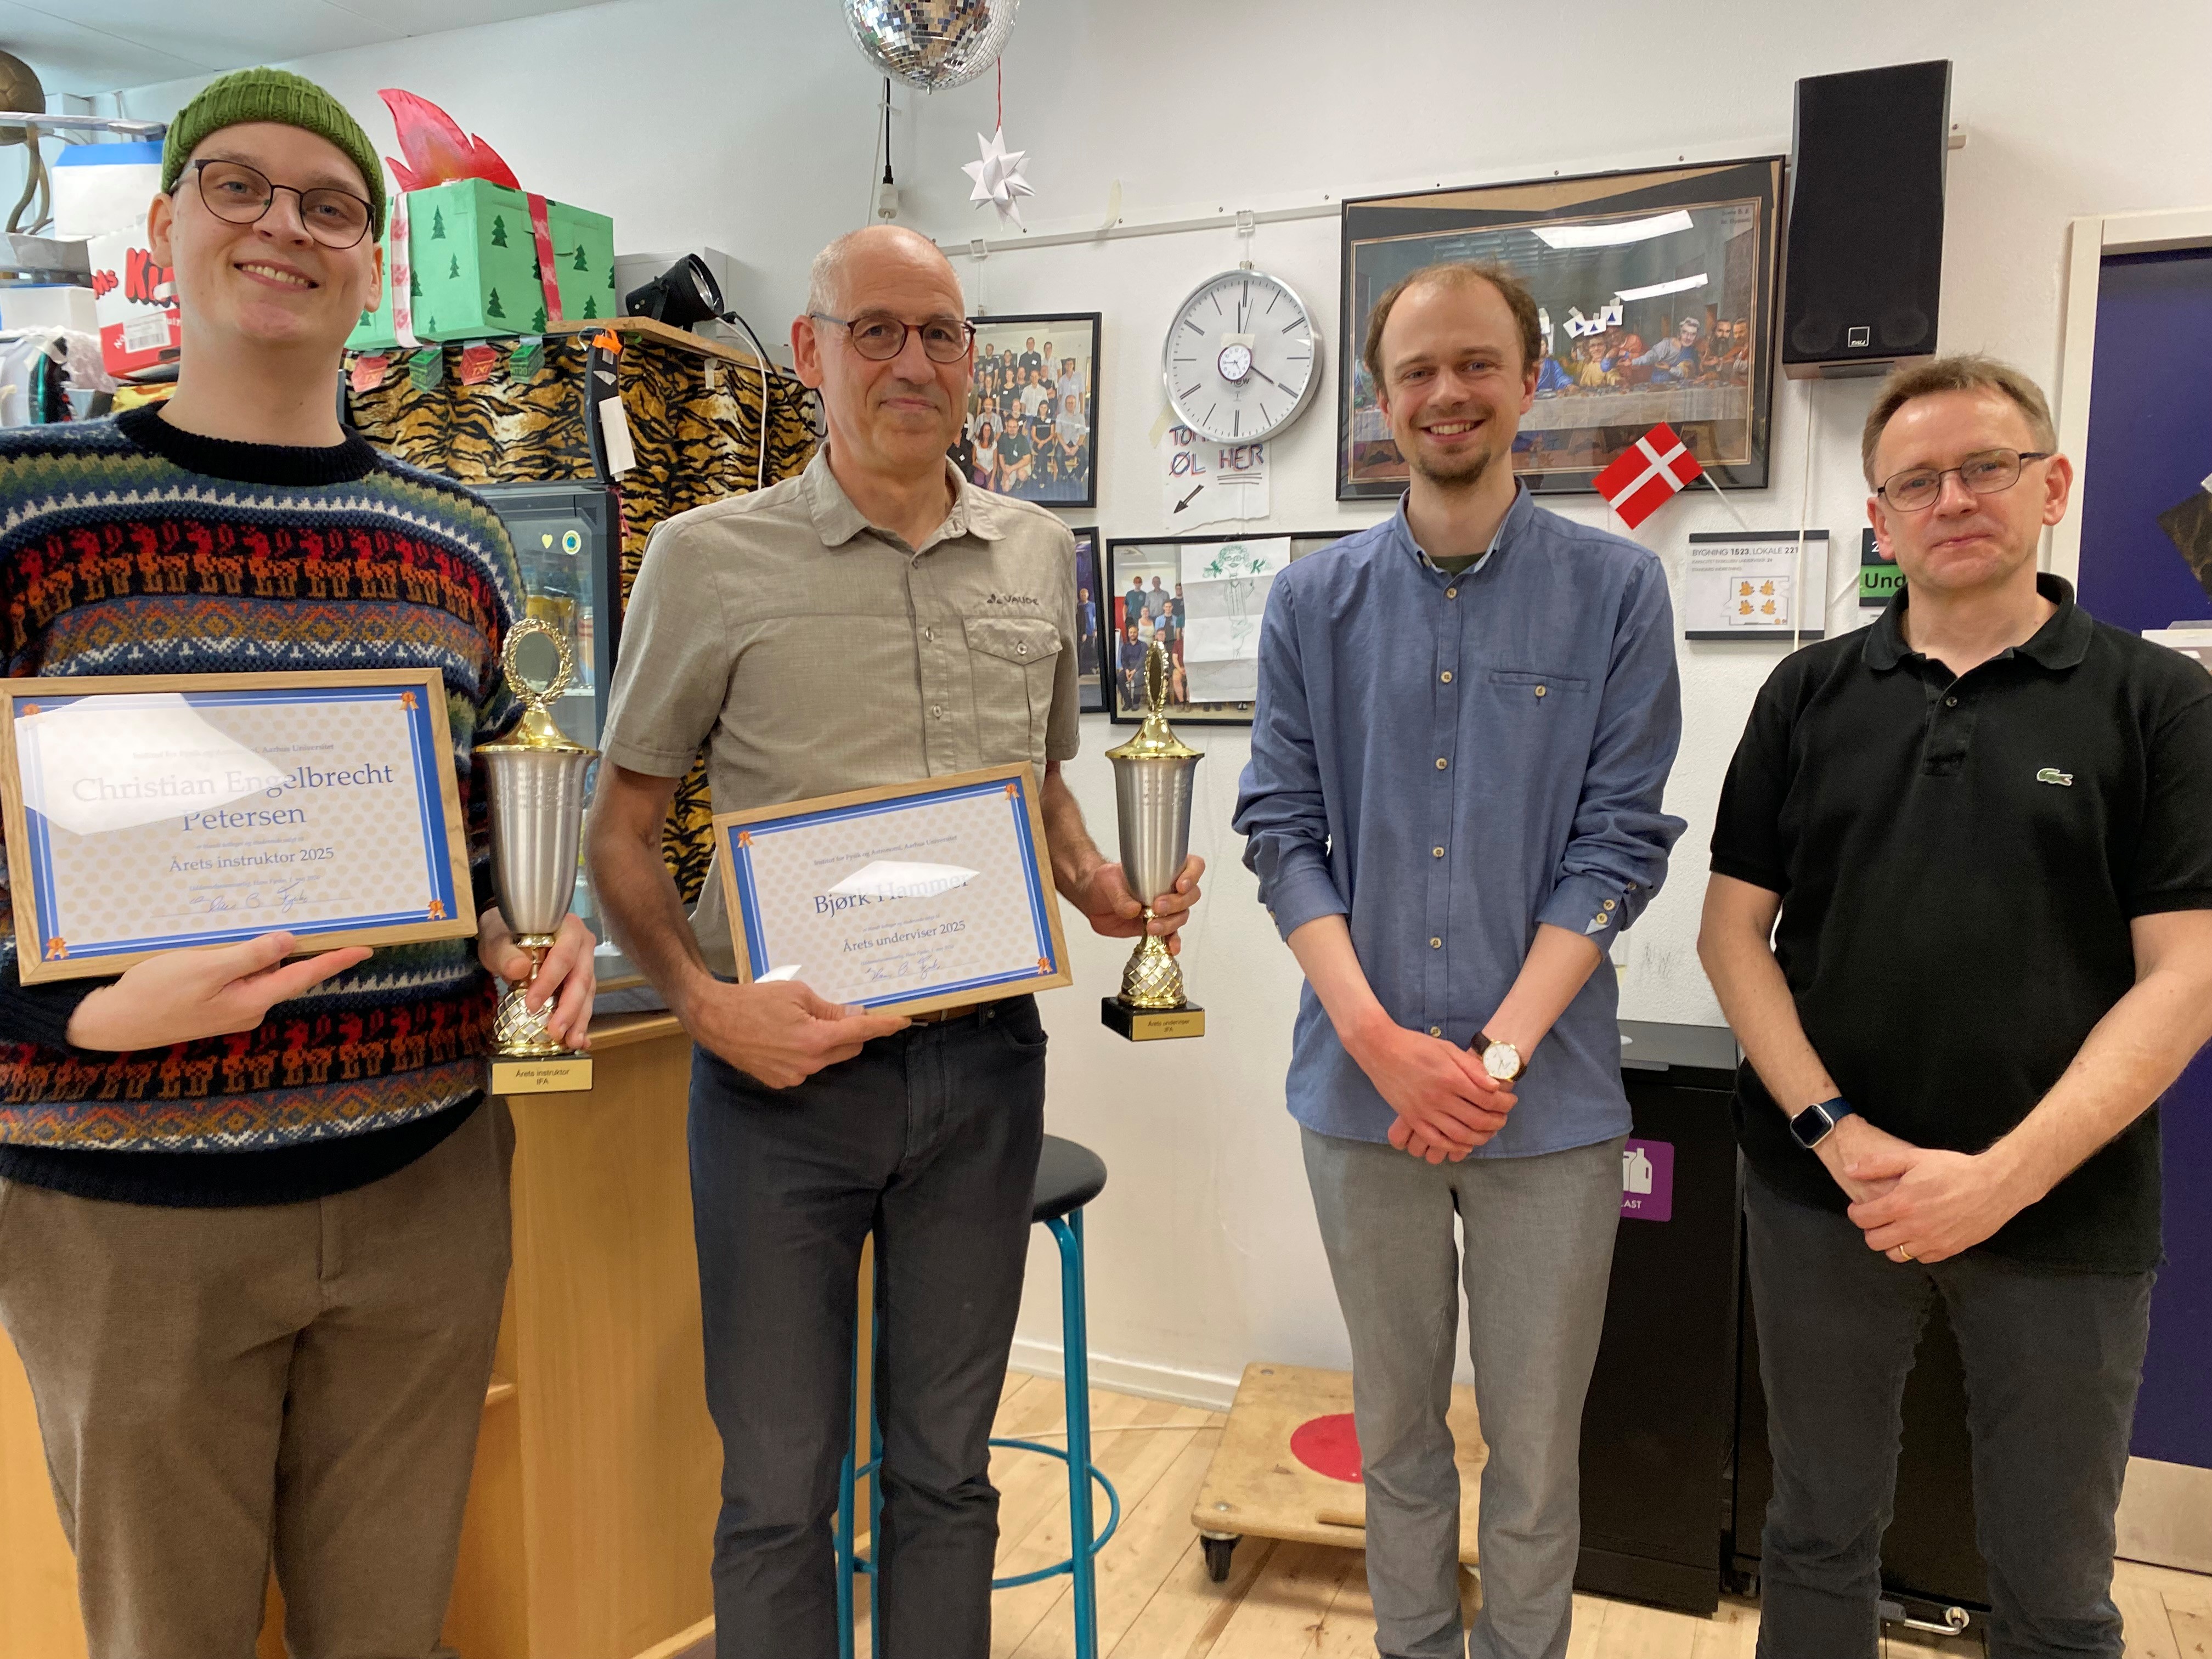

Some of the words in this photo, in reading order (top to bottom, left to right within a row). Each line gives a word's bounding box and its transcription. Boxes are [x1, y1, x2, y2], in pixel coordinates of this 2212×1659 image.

[125, 247, 180, 307] Ki
[1169, 425, 1210, 447] TO
[1169, 450, 1206, 477] ØL
[1219, 444, 1264, 471] HER
[1871, 541, 1880, 552] 2
[1865, 573, 1906, 588] Und
[1003, 595, 1039, 605] VAUDE
[292, 743, 334, 752] Universitet
[72, 774, 216, 802] Christian
[224, 763, 393, 798] Engelbrecht
[182, 808, 306, 831] Petersen
[170, 855, 213, 872] Årets
[217, 851, 296, 869] instruktor
[300, 847, 335, 861] 2025
[812, 888, 871, 918] Bjørk
[877, 873, 969, 903] Hammer
[843, 939, 873, 952] Årets
[876, 928, 937, 946] underviser
[940, 920, 966, 934] 2025
[537, 1069, 571, 1077] instruktor
[1621, 1199, 1642, 1210] AST
